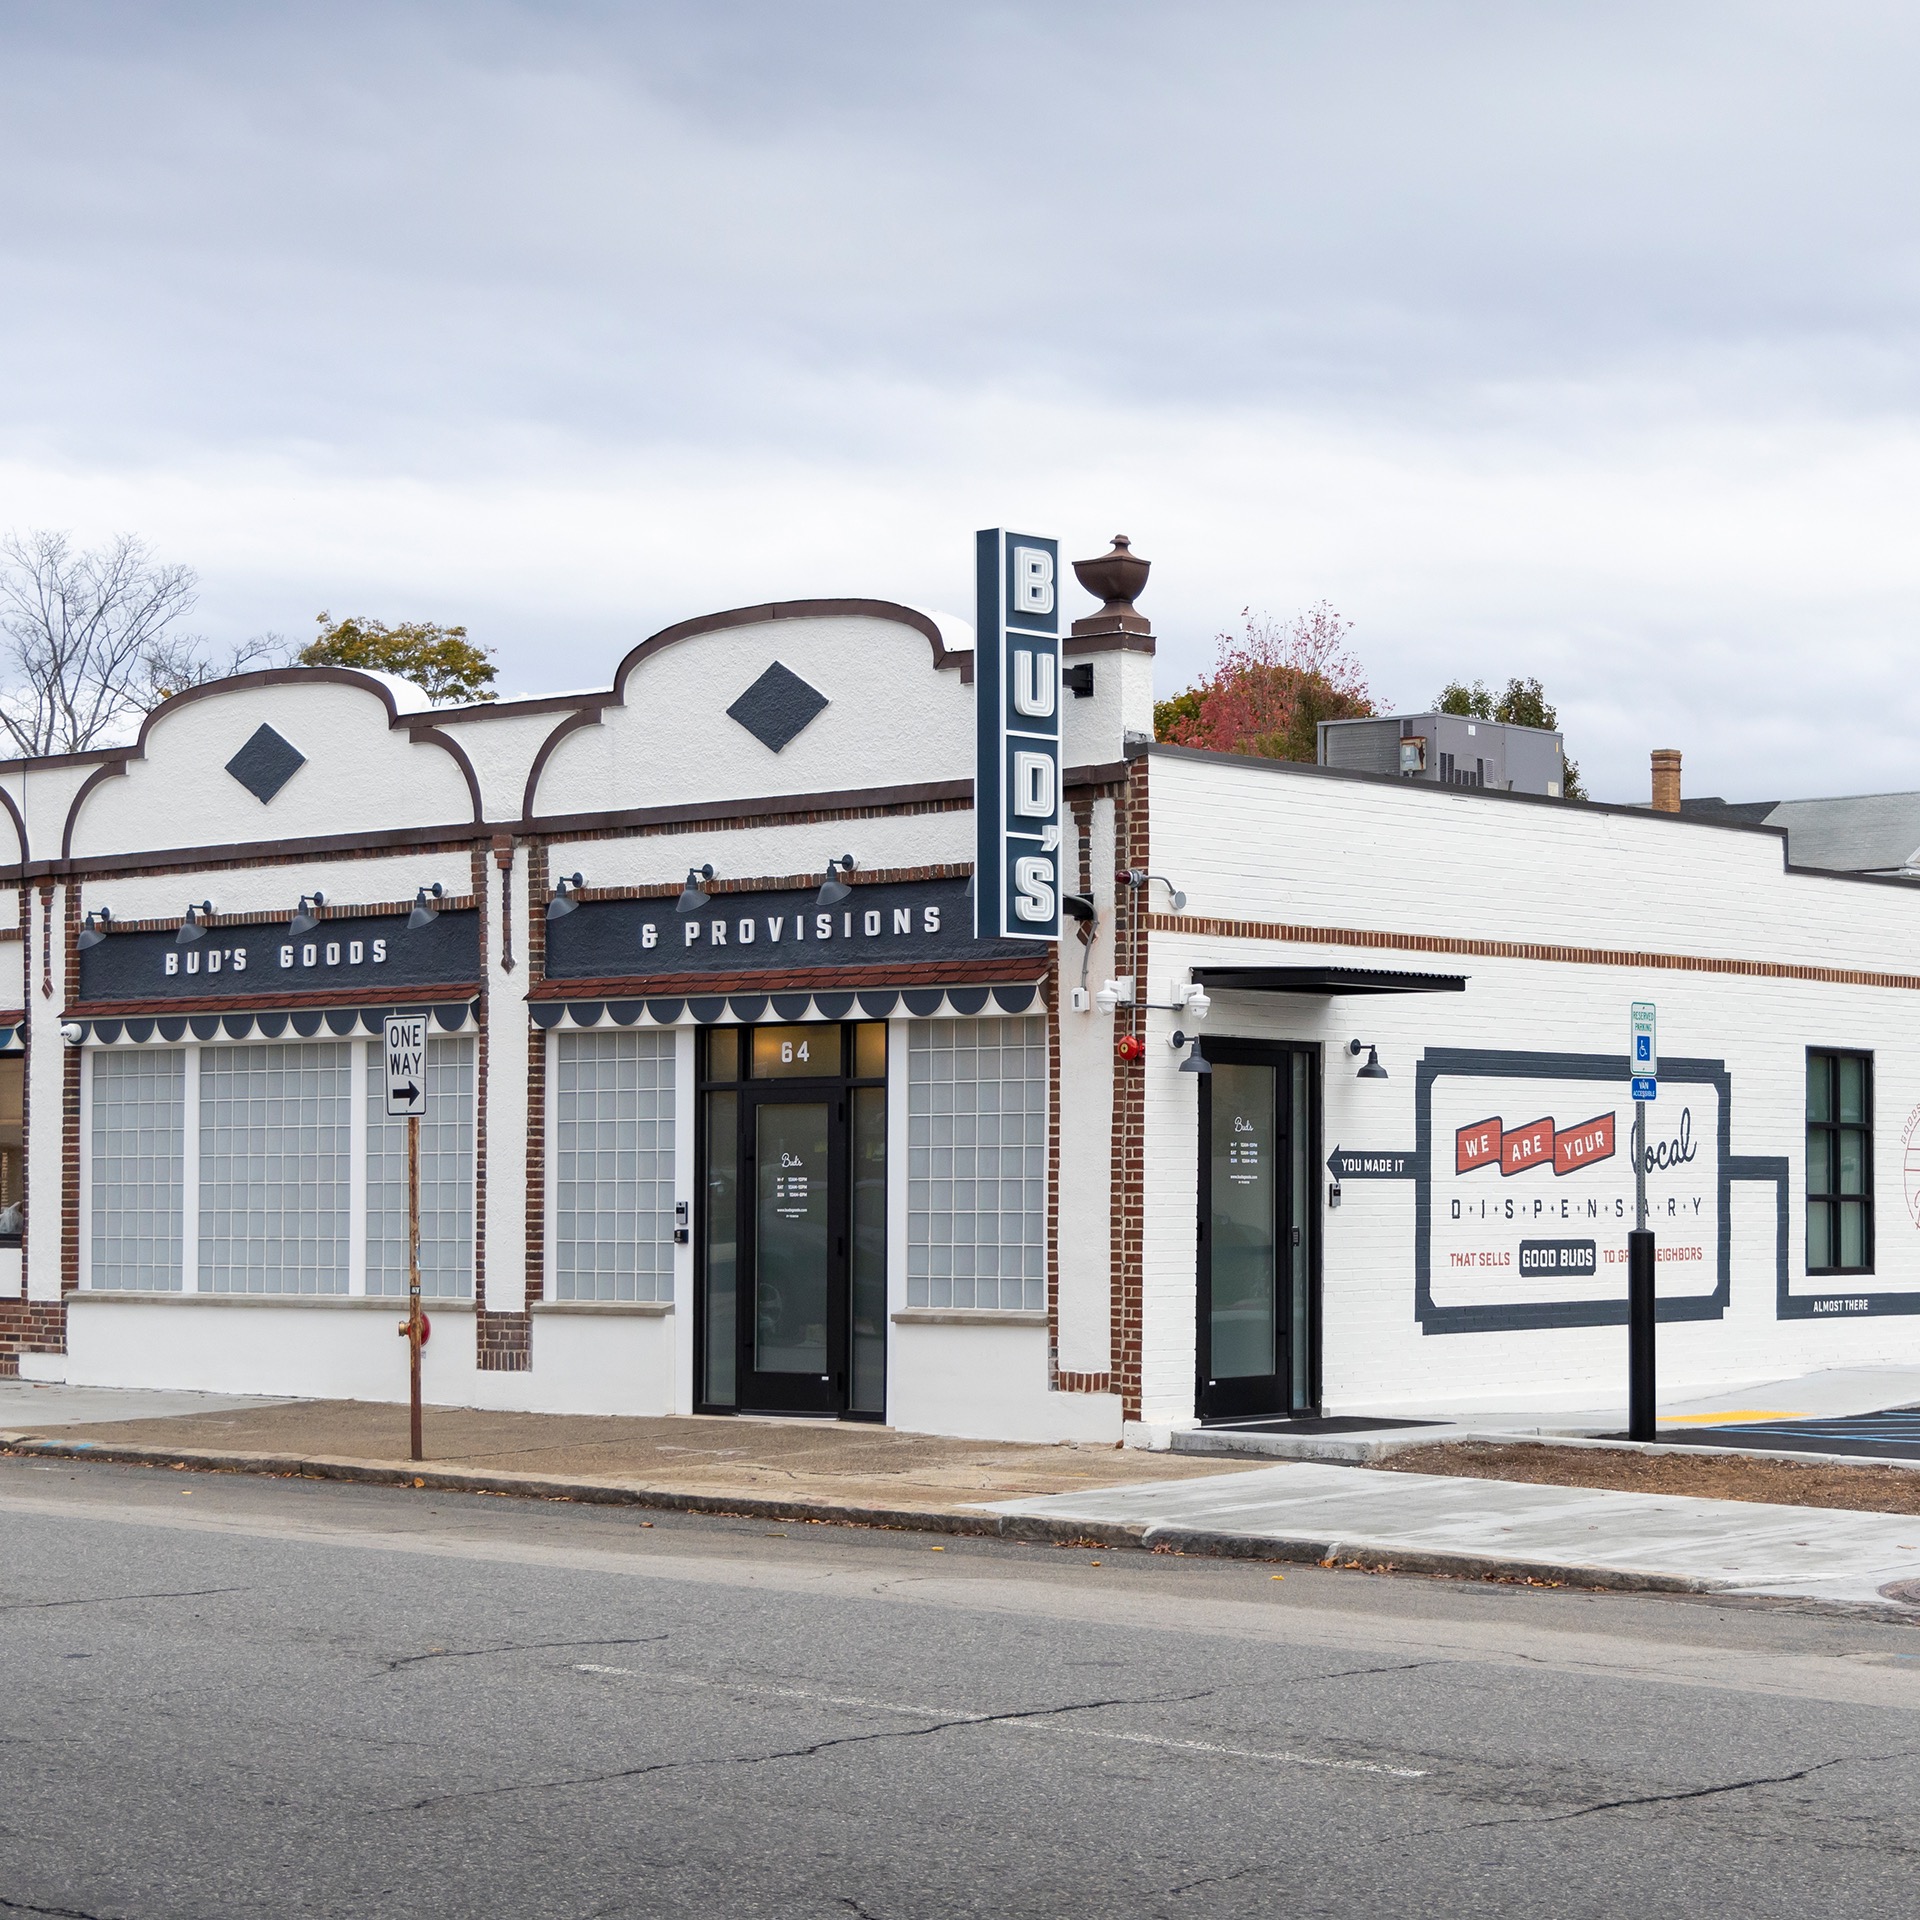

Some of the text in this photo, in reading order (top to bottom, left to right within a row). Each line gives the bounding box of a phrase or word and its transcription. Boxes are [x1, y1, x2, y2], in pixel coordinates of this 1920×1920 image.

[1014, 546, 1060, 923] BUD'S
[642, 906, 941, 948] & PROVISIONS
[165, 939, 387, 976] BUD'S GOODS
[1633, 1011, 1654, 1021] RESERVED
[1635, 1022, 1652, 1032] PARKING
[390, 1025, 421, 1048] ONE
[781, 1041, 810, 1063] 64
[390, 1052, 422, 1076] WAY
[1638, 1081, 1649, 1090] VAN
[1465, 1134, 1490, 1158] WE
[1512, 1134, 1542, 1162] ARE
[1563, 1130, 1605, 1160] YOUR
[1341, 1158, 1405, 1172] YOU MADE IT
[1450, 1253, 1477, 1267] THAT
[1479, 1252, 1510, 1266] SELLS
[1522, 1249, 1556, 1268] GOOD
[1559, 1248, 1593, 1267] BUDS
[1603, 1250, 1615, 1263] TO
[1654, 1247, 1703, 1262] EIGHBORS
[1813, 1299, 1869, 1312] ALMOST THERE
